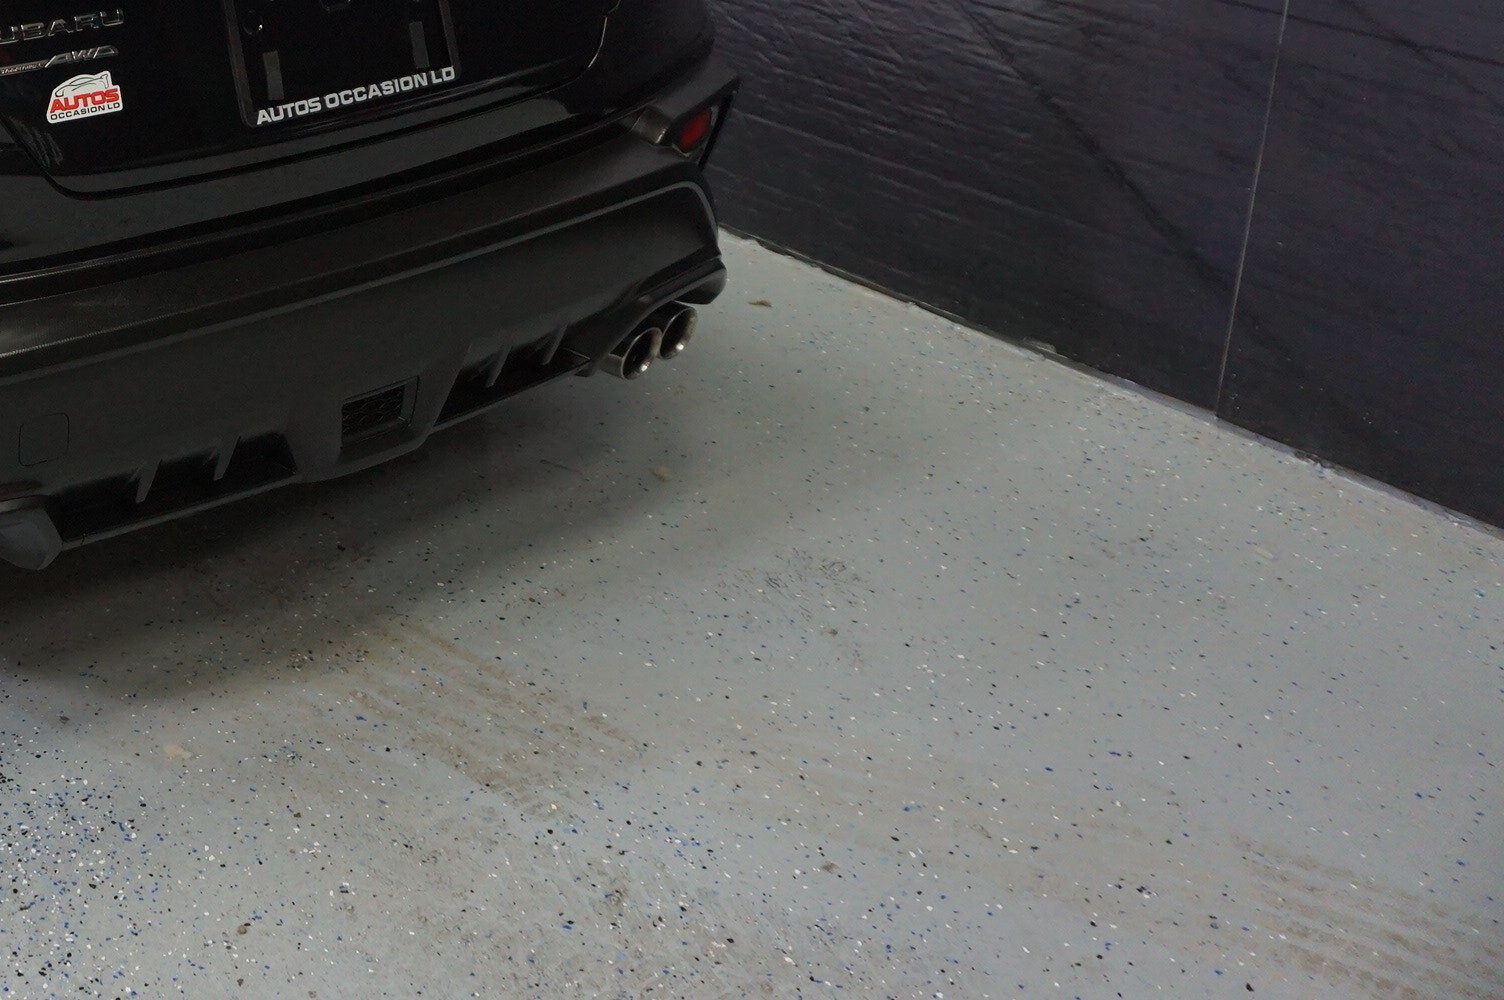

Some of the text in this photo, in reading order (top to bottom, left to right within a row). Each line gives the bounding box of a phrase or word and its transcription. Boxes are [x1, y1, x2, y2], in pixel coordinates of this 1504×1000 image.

[45, 45, 119, 68] AWD
[50, 88, 121, 114] AUTOS
[256, 66, 456, 126] AUTOS OCCASION LD
[50, 102, 120, 121] OCCASION LD
